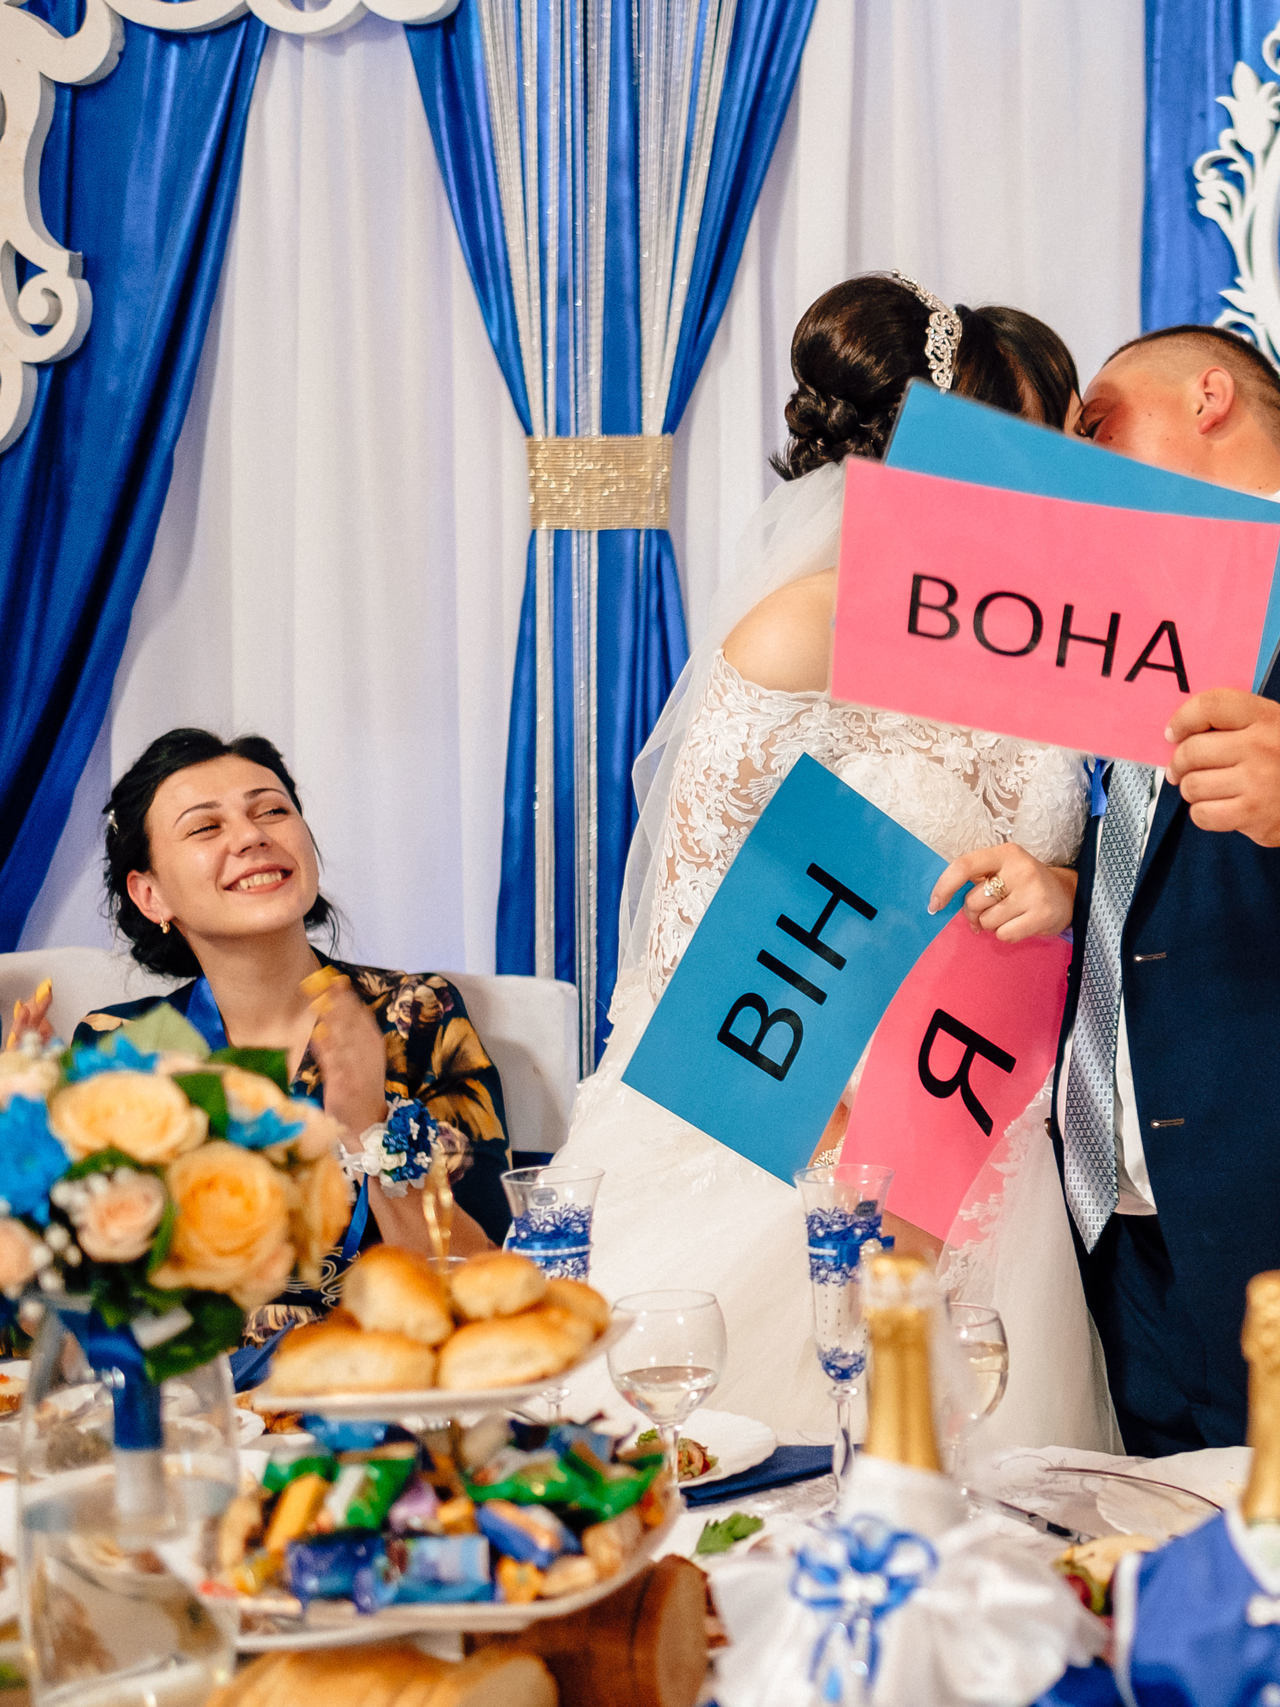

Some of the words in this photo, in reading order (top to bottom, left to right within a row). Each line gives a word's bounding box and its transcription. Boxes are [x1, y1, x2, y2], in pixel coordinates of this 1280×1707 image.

[907, 574, 1190, 693] ВОНА
[716, 862, 878, 1082] ВІН
[918, 1008, 1017, 1137] Я
